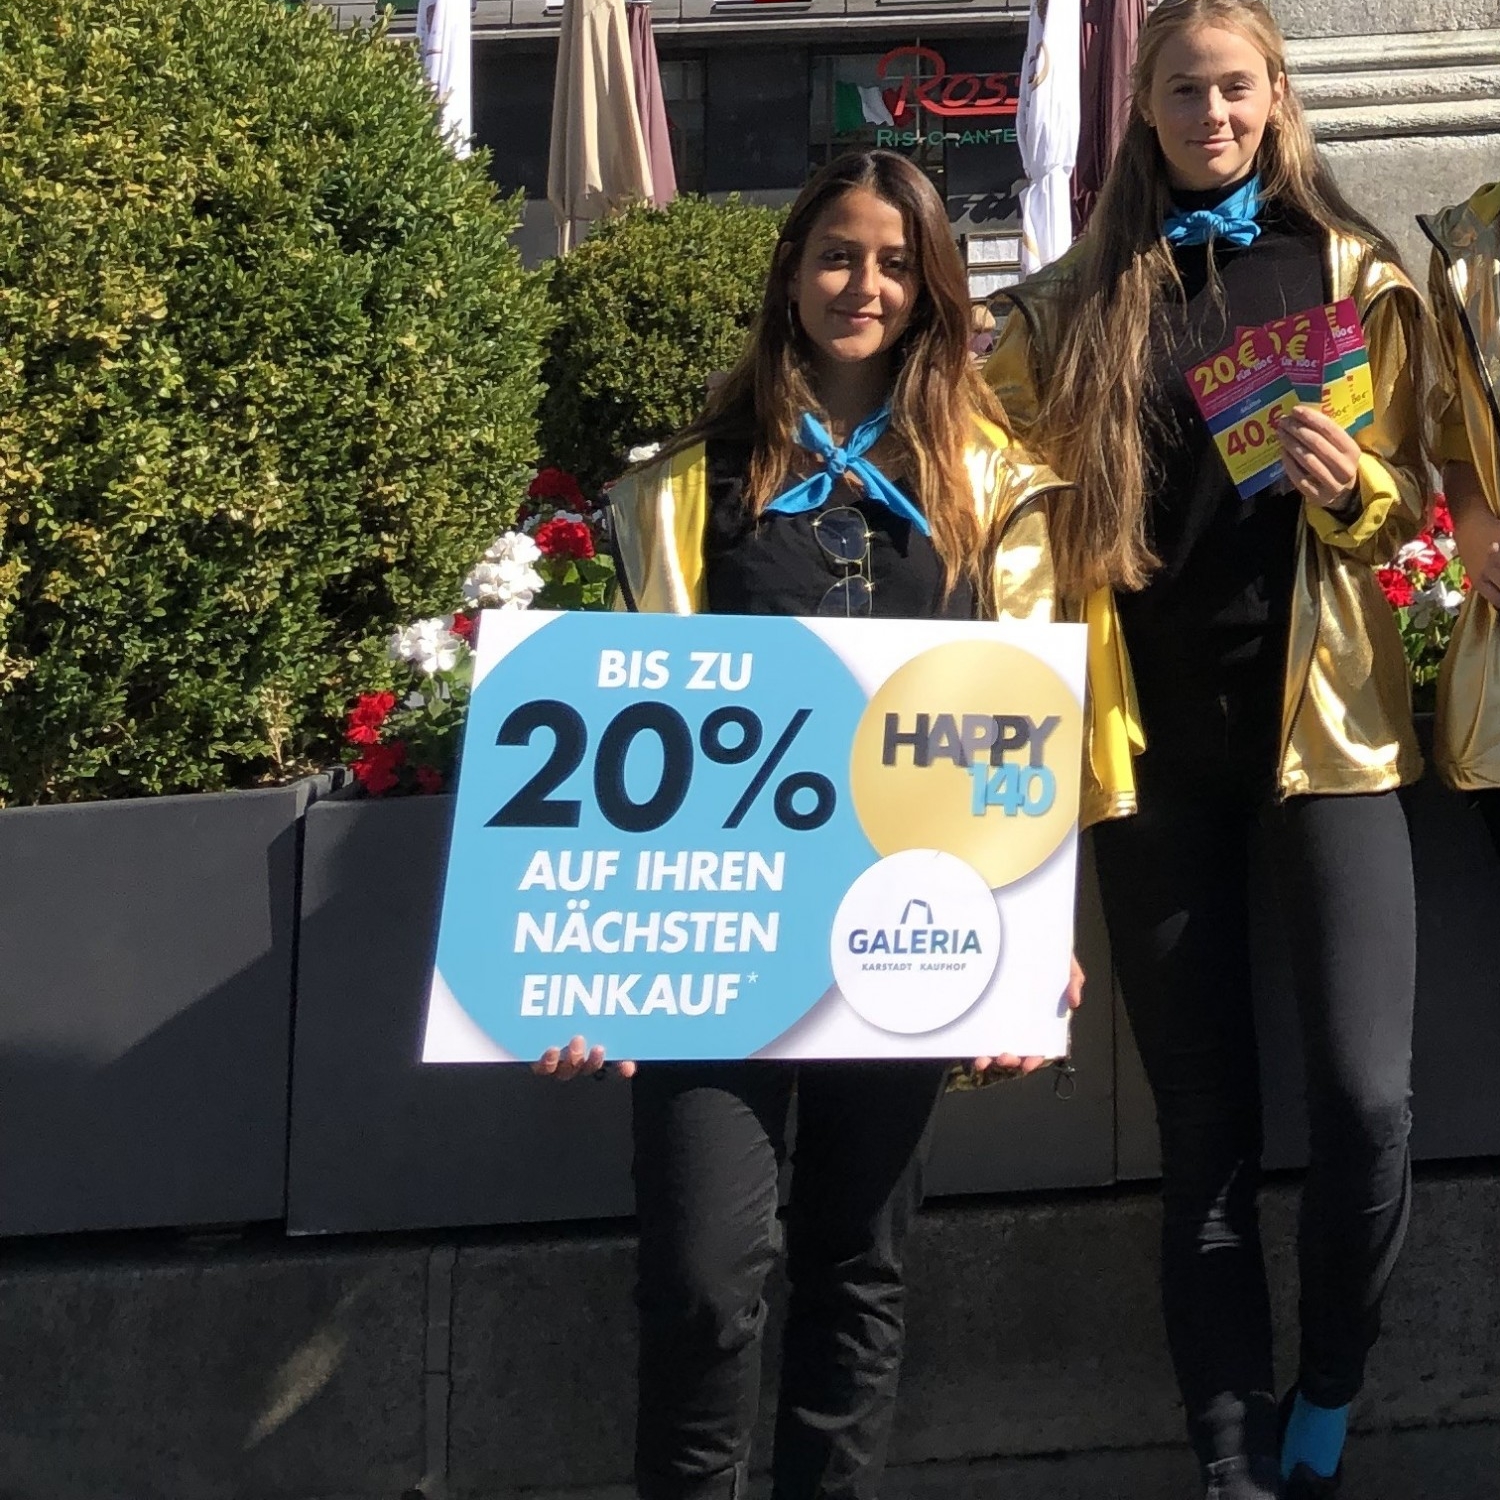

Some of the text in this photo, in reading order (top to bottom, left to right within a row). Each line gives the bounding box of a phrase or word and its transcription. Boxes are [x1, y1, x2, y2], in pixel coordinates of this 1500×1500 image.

[876, 129, 1017, 147] RISOANTE
[598, 649, 753, 690] BIS ZU
[882, 712, 1062, 768] HAPPY
[483, 698, 837, 833] 20%
[968, 760, 1056, 817] 140
[518, 850, 786, 892] AUF IHREN
[514, 899, 779, 953] NÄCHSTEN
[848, 929, 983, 954] GALERIA
[862, 963, 967, 971] KARSTADT KAUFHOF
